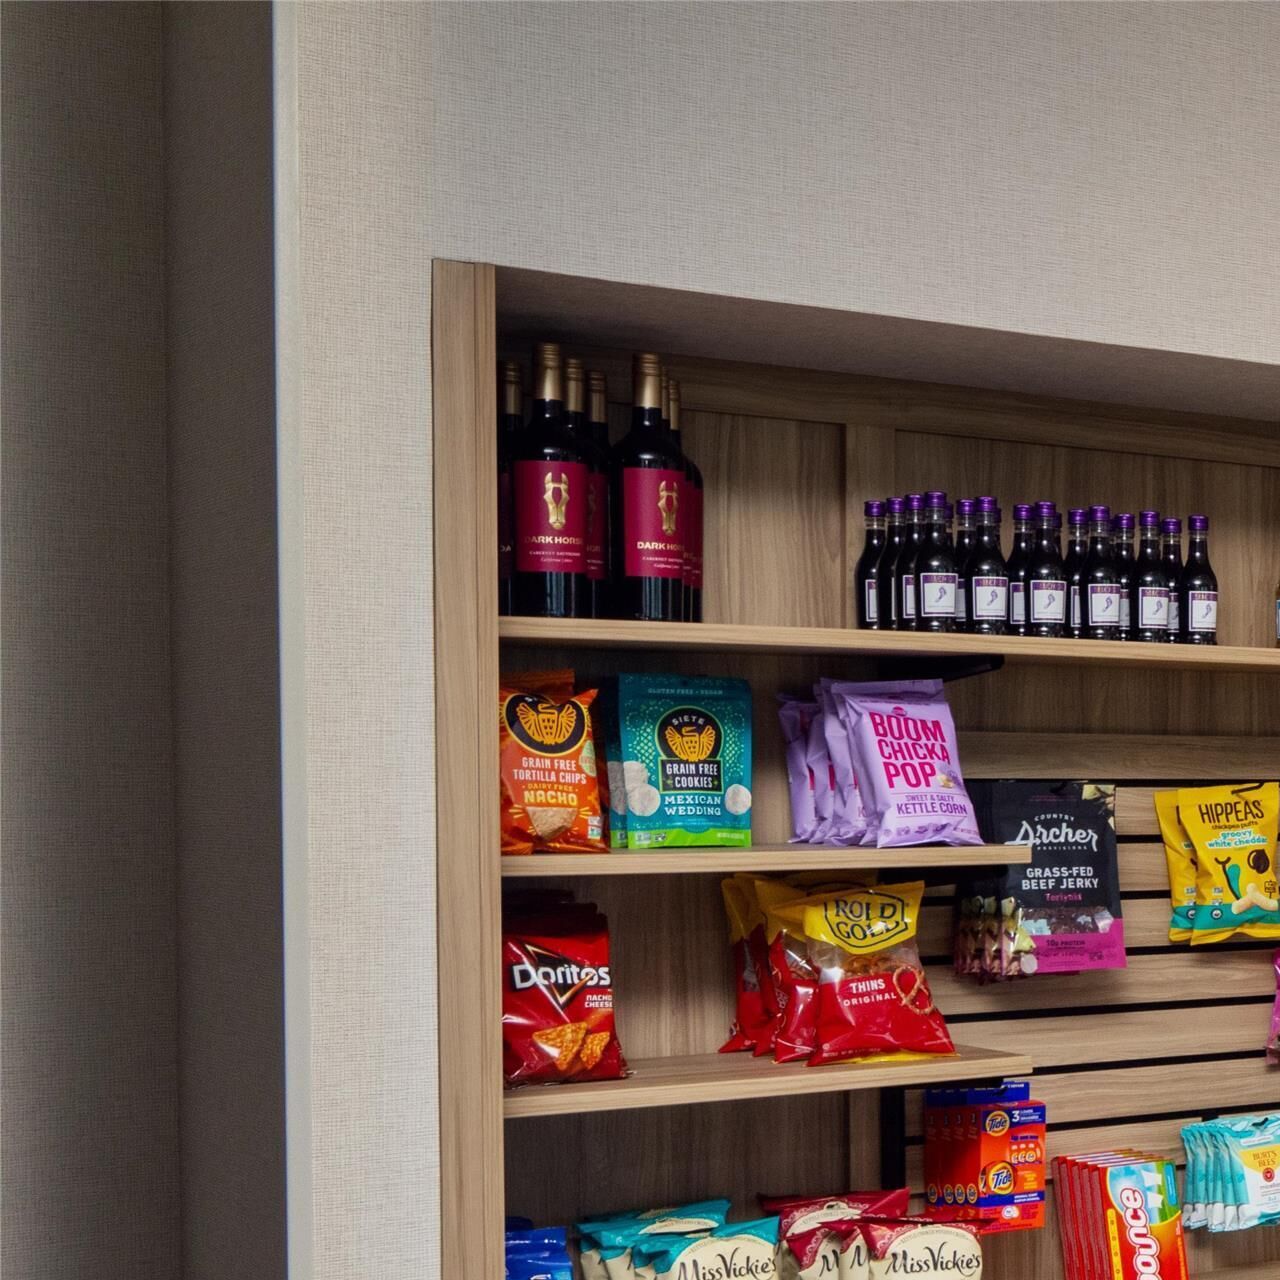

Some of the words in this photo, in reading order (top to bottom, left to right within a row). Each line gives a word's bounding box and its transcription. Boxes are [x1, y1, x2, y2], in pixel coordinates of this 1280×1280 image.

[869, 712, 946, 743] BOOM
[877, 739, 950, 766] CHICKA
[513, 769, 557, 783] TORTILLA
[559, 772, 587, 785] CHIPS
[883, 762, 936, 789] POP
[524, 791, 578, 806] NACHO
[897, 802, 937, 815] KETTLE
[939, 803, 968, 815] CORN
[1198, 800, 1265, 823] HIPPEAS
[1034, 813, 1075, 822] COUNTRY
[1004, 819, 1098, 852] Archer
[1220, 829, 1252, 841] groovy
[1026, 866, 1094, 878] GRASS-FED
[1021, 878, 1057, 890] BEEF
[1060, 878, 1099, 890] JERKY
[513, 962, 610, 989] Doritos
[850, 978, 886, 993] THINS
[842, 992, 897, 1007] ORIGINAL
[1012, 1111, 1019, 1122] 3
[988, 1117, 1009, 1133] Tide
[1252, 1148, 1277, 1161] BURT'S
[1258, 1158, 1276, 1168] BEES
